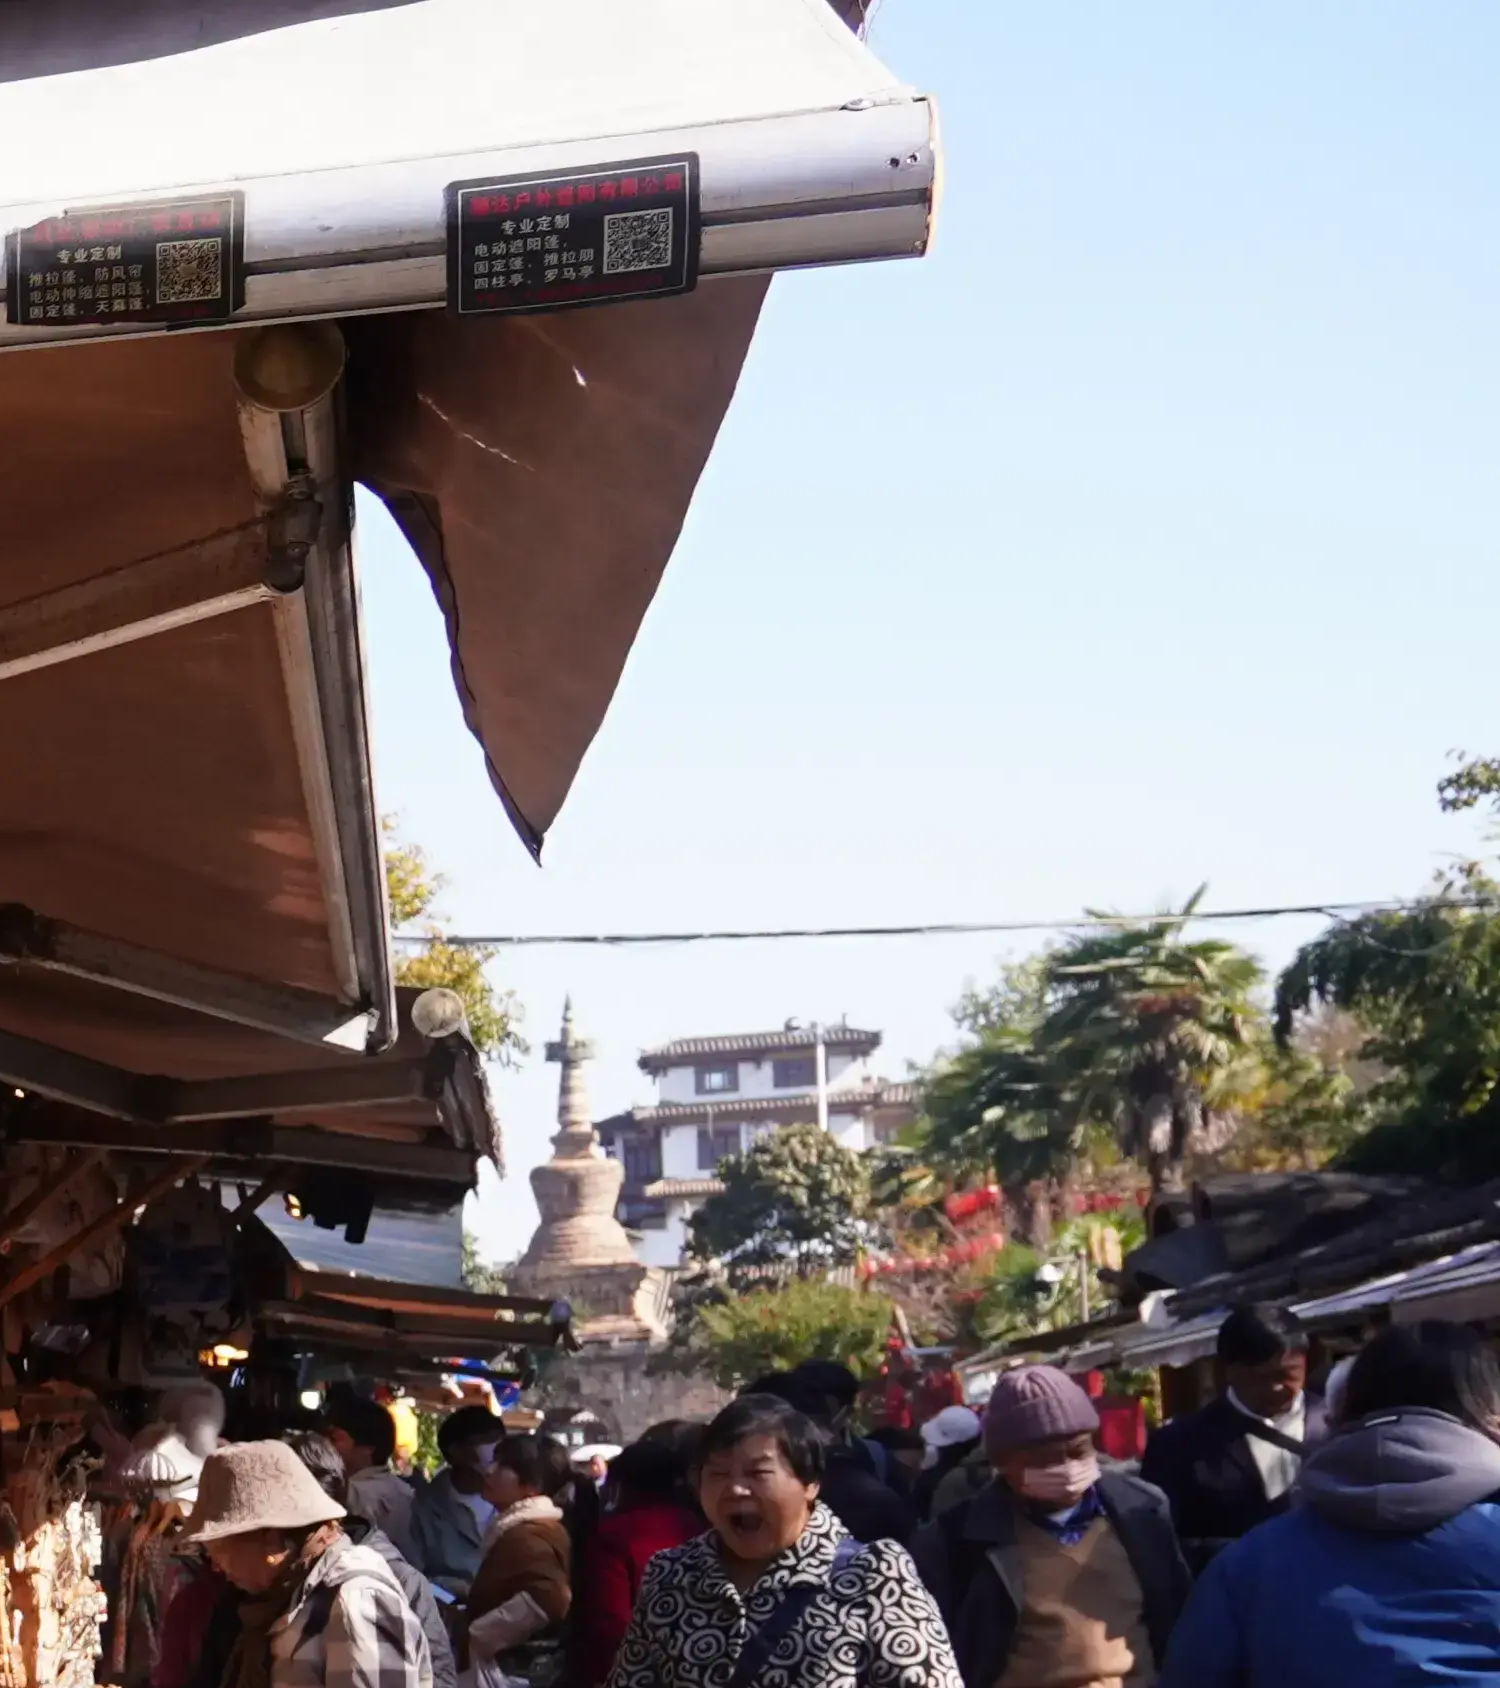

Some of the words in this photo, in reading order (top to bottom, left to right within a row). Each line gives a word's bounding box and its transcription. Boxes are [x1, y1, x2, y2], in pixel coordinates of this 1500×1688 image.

[501, 213, 570, 235] 专业定制
[56, 245, 122, 264] 专业定制
